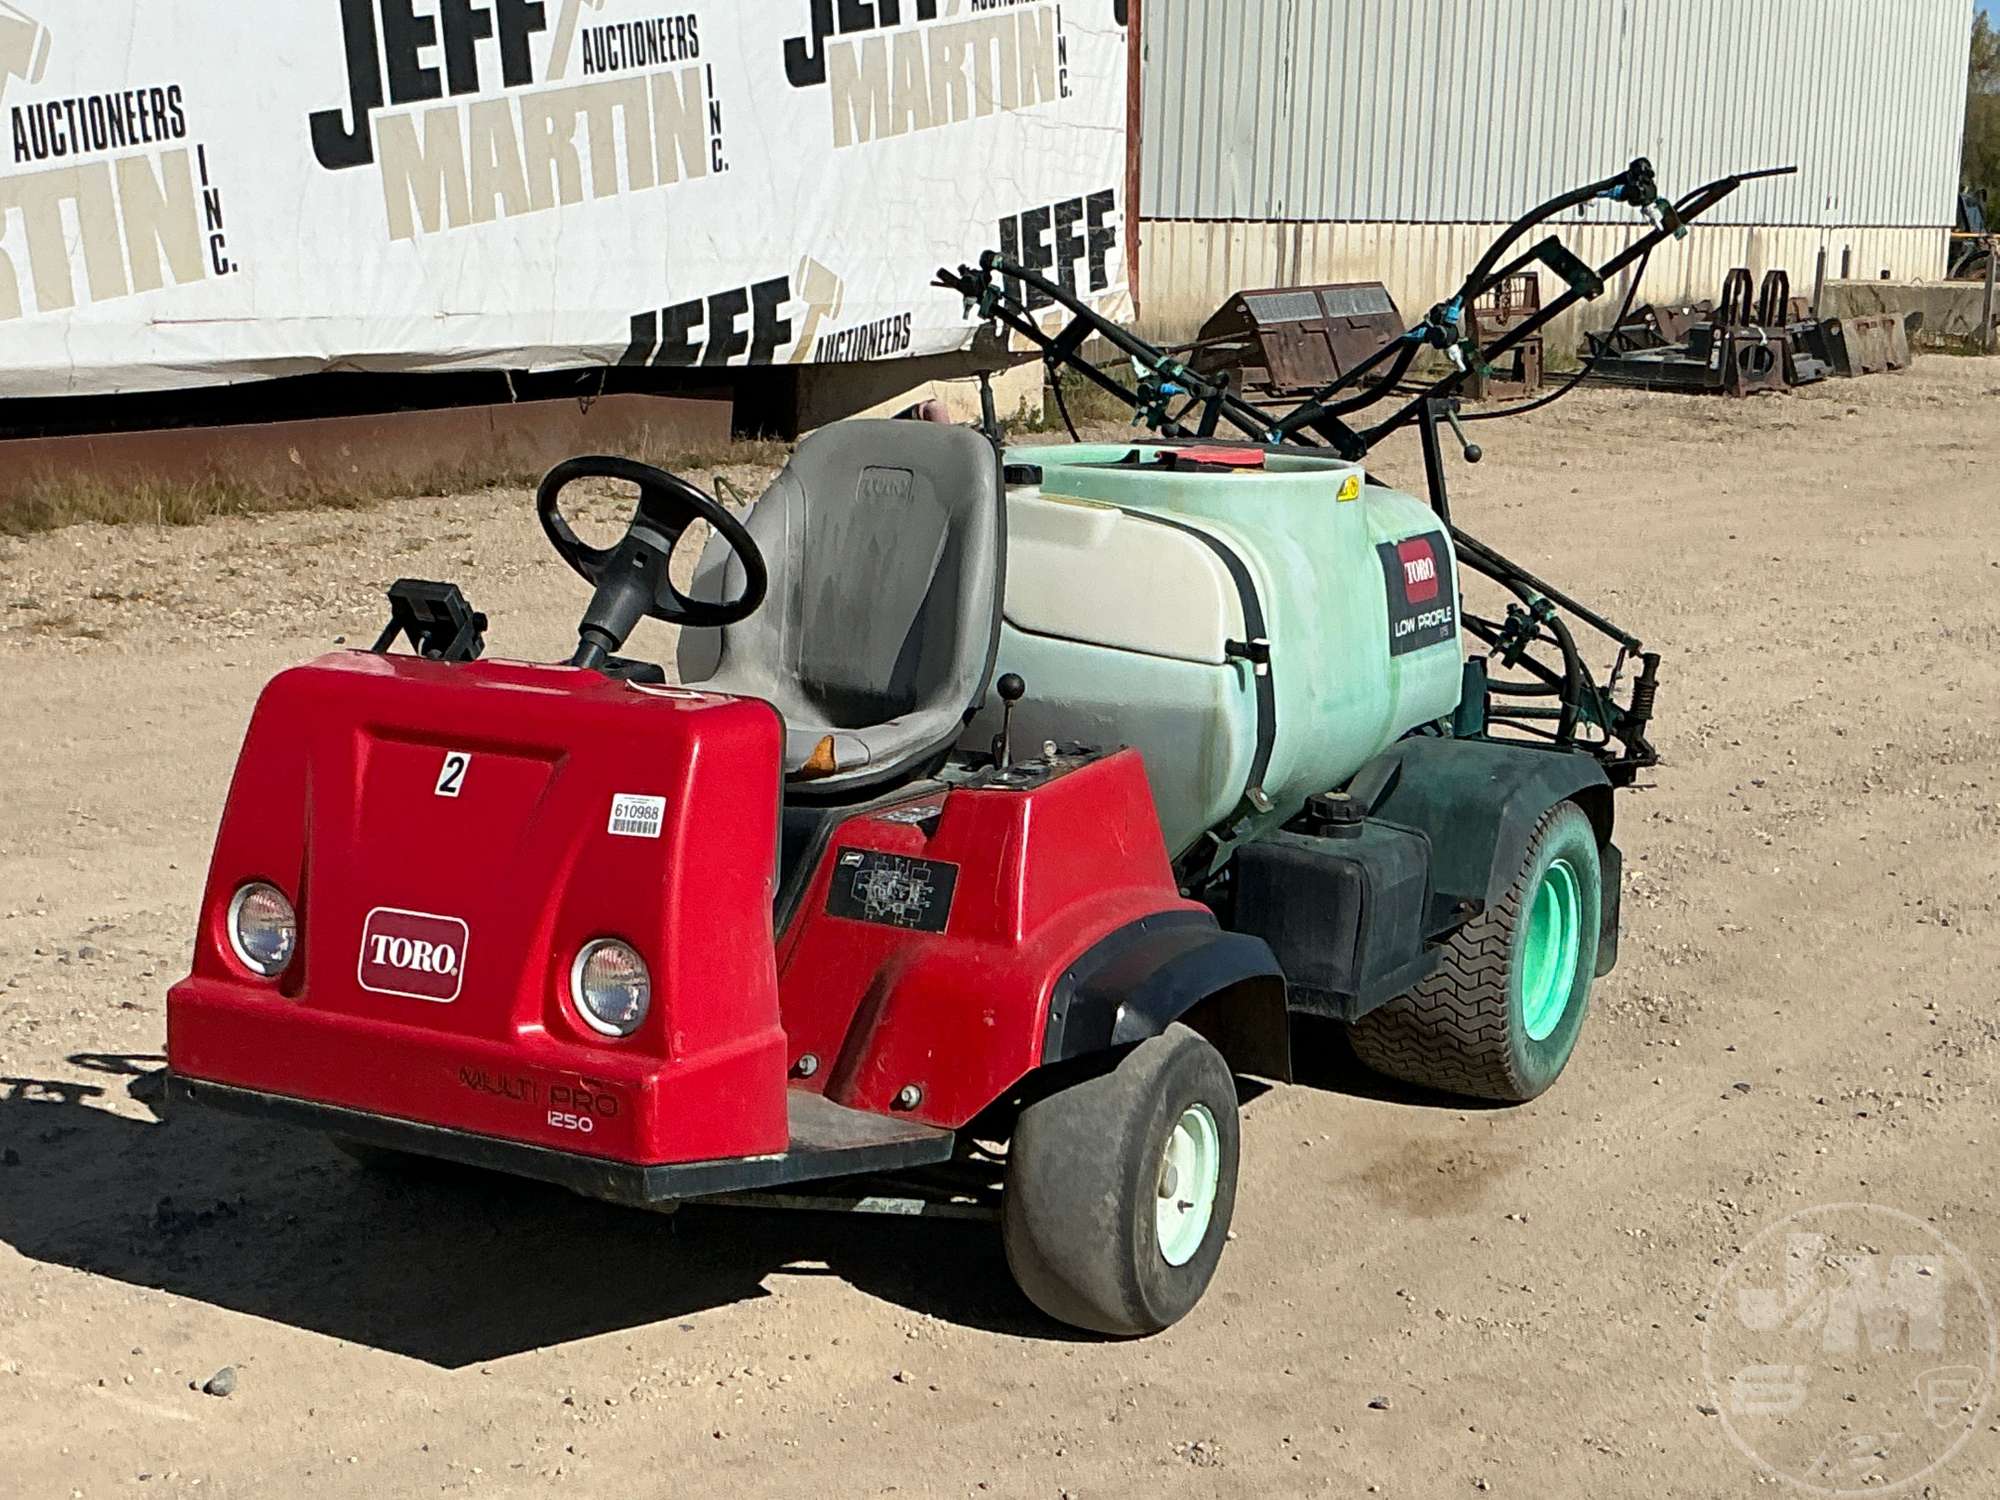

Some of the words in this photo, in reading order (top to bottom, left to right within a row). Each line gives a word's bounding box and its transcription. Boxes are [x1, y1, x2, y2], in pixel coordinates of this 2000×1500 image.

[582, 13, 700, 75] AUCTIONEERS
[1056, 4, 1073, 98] INC.
[828, 7, 1056, 148] MARTIN
[11, 84, 187, 163] AUCTIONEERS
[705, 63, 729, 173] INC.
[375, 66, 707, 241] MARTIN
[197, 143, 238, 276] INC.
[1404, 557, 1434, 584] TORO
[1395, 617, 1416, 637] LOW
[1418, 607, 1452, 630] PROFILE
[439, 756, 464, 793] 2
[615, 803, 660, 820] 610988
[370, 934, 456, 974] TORO
[548, 1084, 621, 1118] PRO
